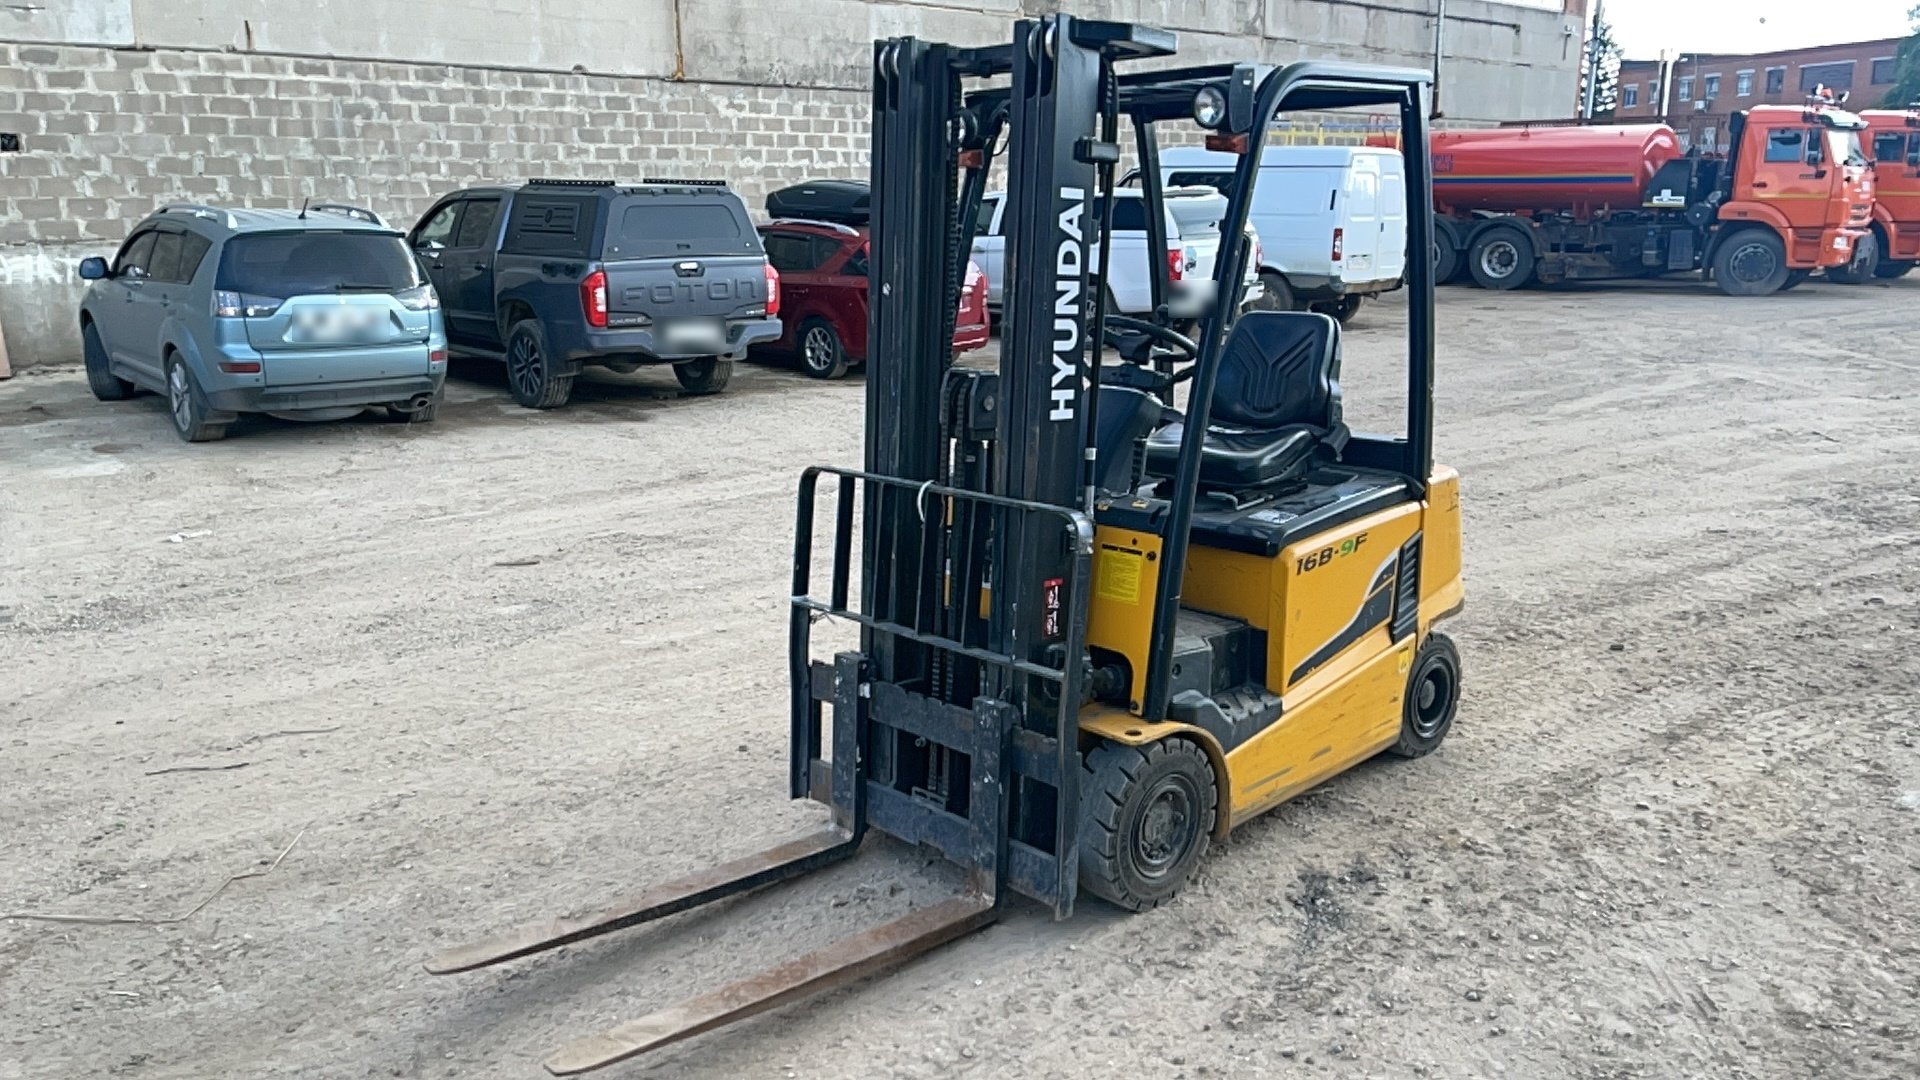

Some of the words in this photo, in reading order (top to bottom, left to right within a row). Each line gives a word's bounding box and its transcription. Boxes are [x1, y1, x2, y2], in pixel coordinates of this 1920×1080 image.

[620, 277, 757, 306] FOTON
[1049, 186, 1085, 421] HYUNDAI
[1296, 532, 1368, 576] 16B-9F
